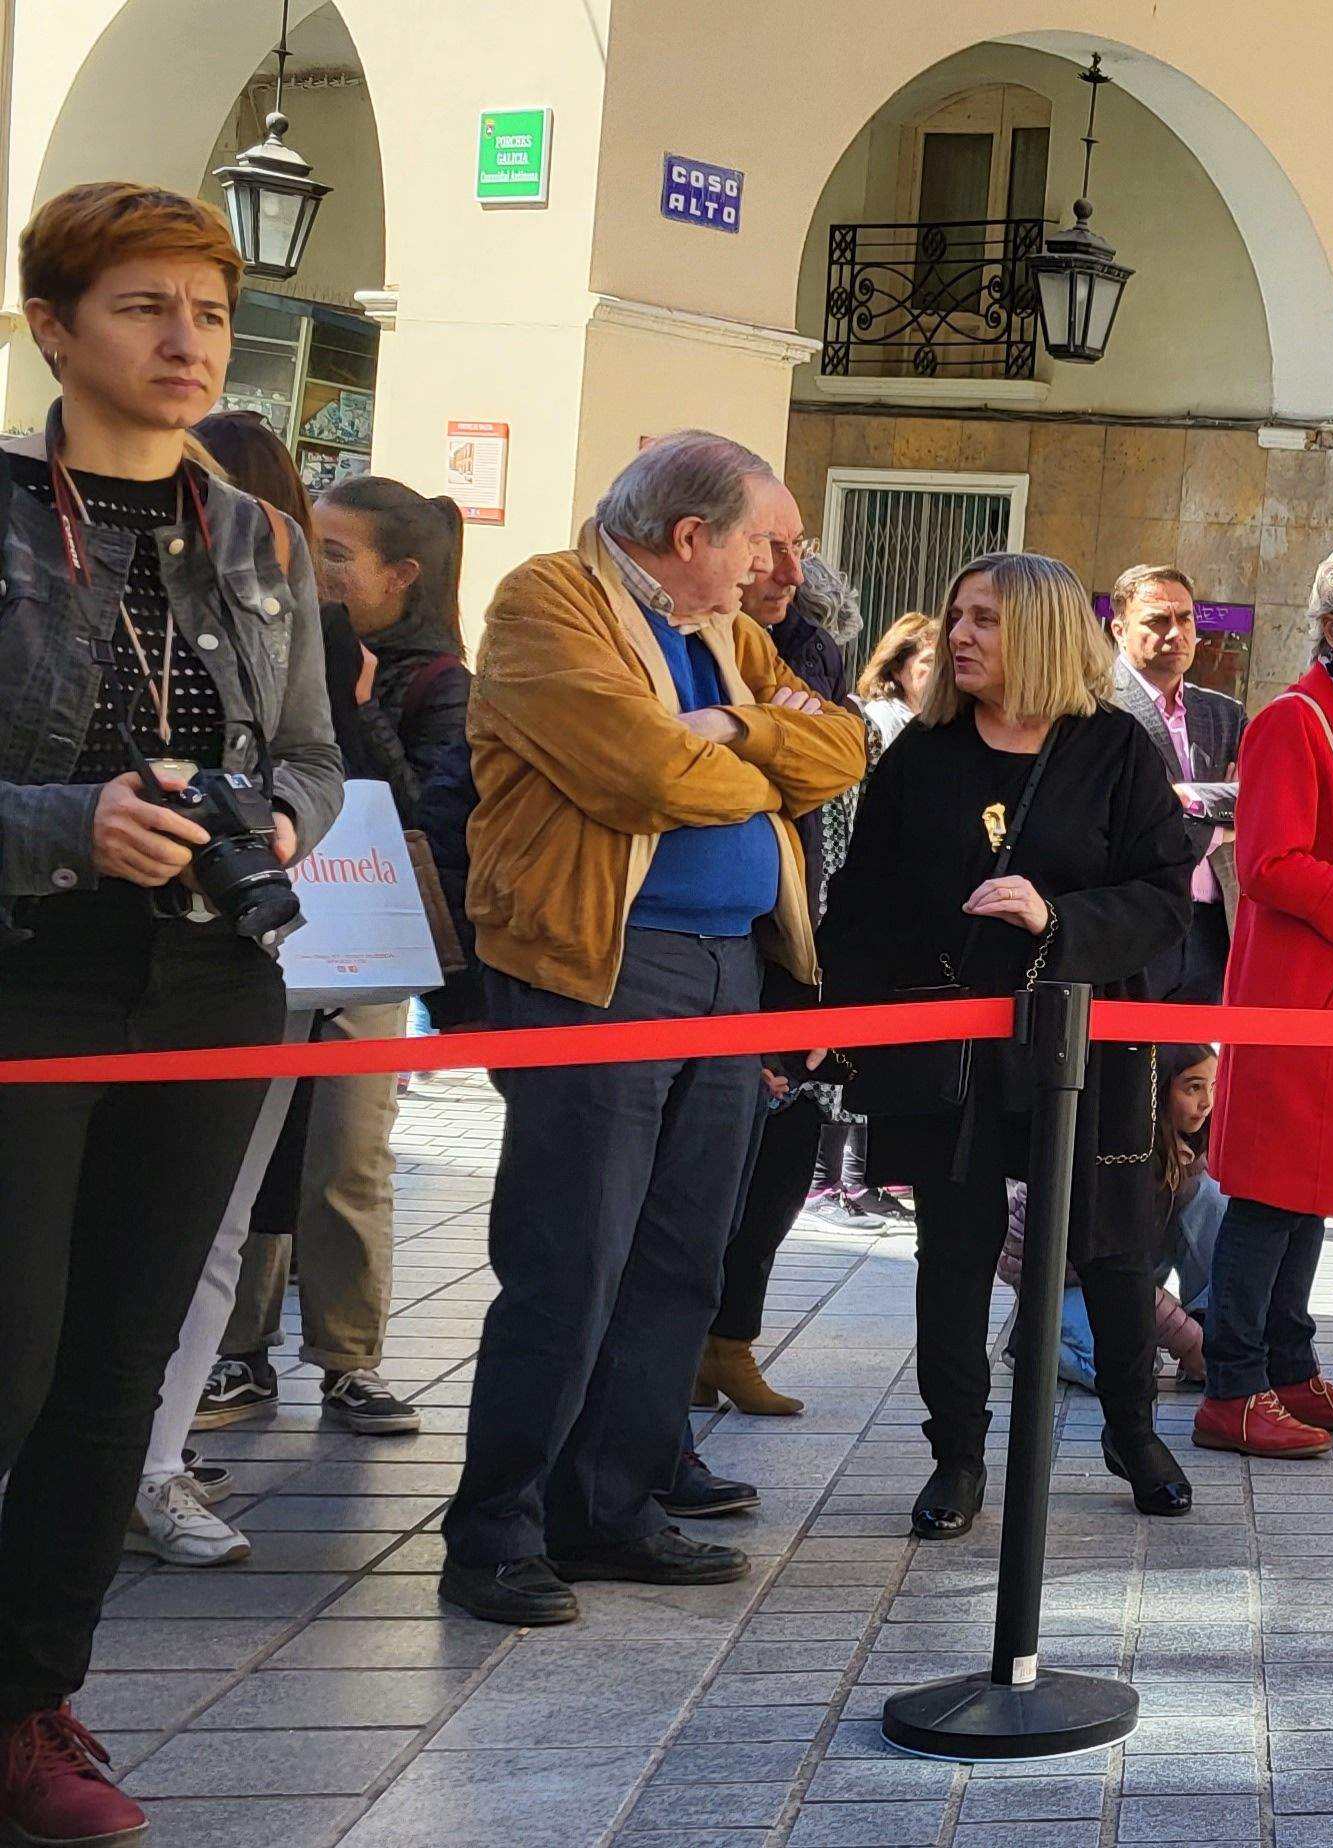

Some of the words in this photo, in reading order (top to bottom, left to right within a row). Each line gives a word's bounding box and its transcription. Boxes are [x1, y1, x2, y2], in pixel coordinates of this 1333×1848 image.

[495, 135, 531, 149] PORCHES
[496, 151, 529, 165] GALICIA
[671, 165, 738, 197] COSO
[668, 193, 736, 224] ALTO
